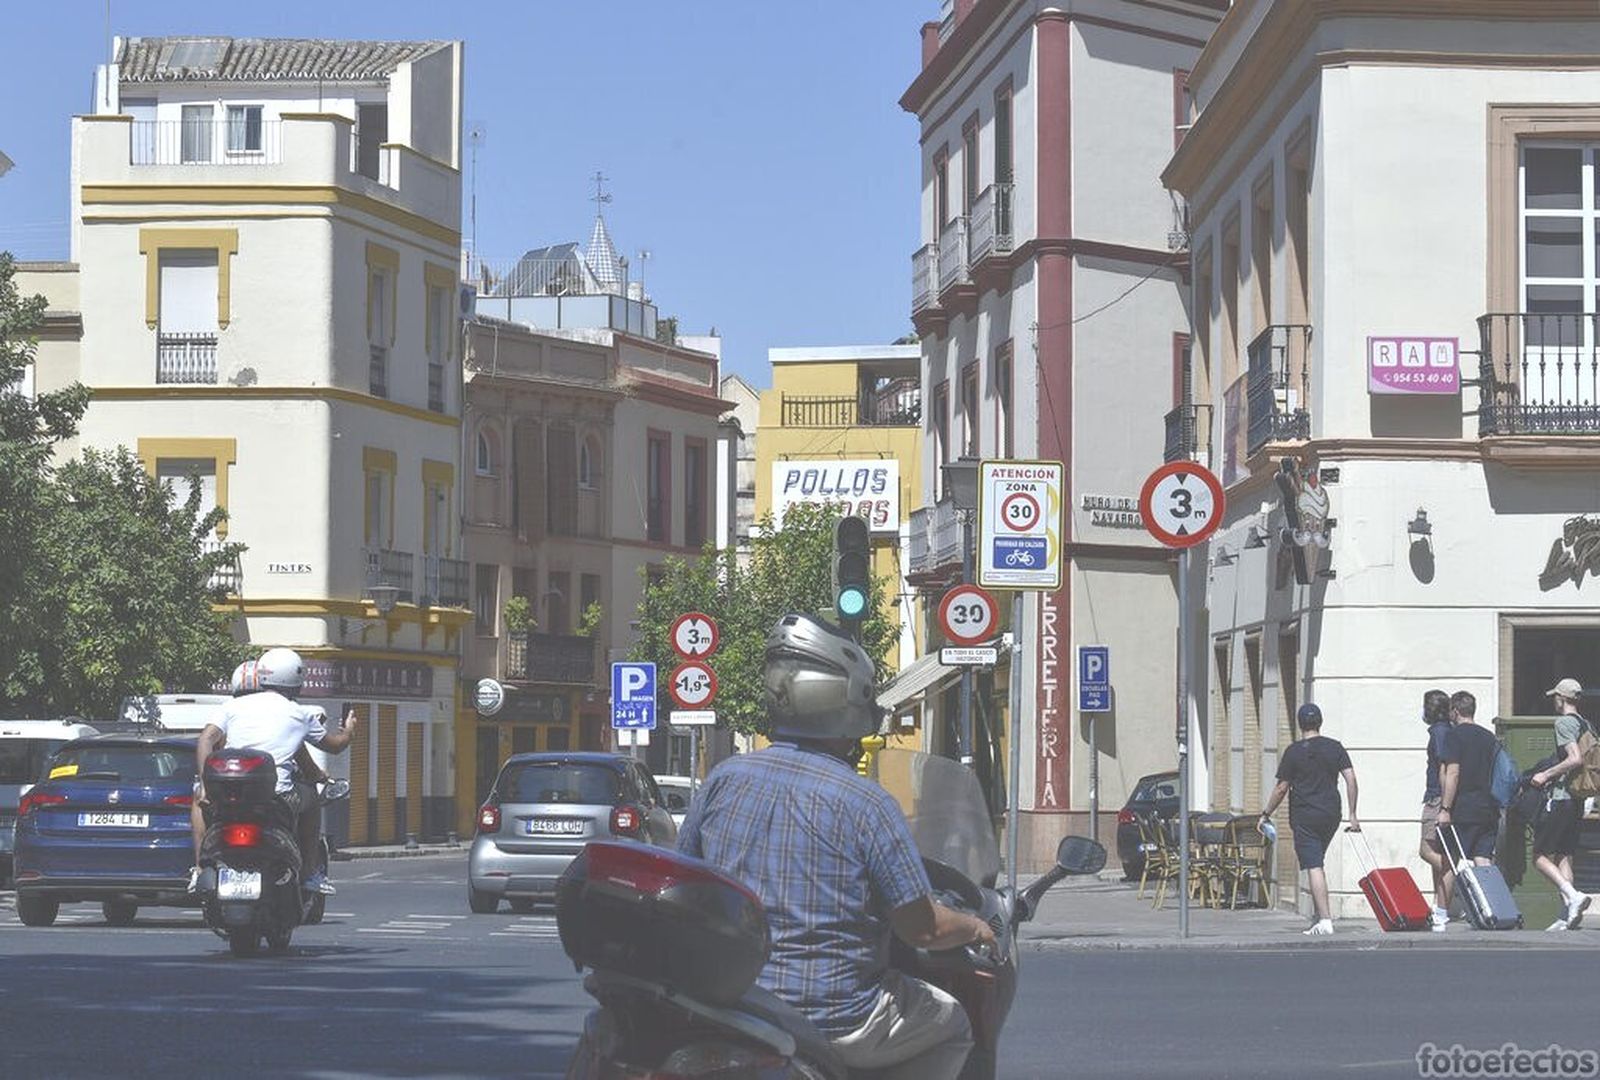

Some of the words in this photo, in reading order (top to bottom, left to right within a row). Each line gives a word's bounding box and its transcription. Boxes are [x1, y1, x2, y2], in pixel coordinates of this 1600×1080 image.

[1393, 372, 1411, 383] 954
[1412, 372, 1425, 383] 53
[1427, 373, 1440, 383] 40
[1441, 373, 1454, 384] 40
[991, 468, 1055, 479] ATENCIÓN
[783, 468, 889, 497] POLLOS
[1005, 482, 1037, 492] ZONA
[1083, 496, 1111, 508] MURO
[1119, 499, 1130, 509] DE
[1010, 504, 1032, 519] 30
[268, 563, 313, 573] TINTES
[953, 604, 984, 624] 30
[1088, 655, 1102, 680] P
[621, 667, 647, 701] P
[615, 710, 627, 718] 24
[628, 710, 636, 718] H
